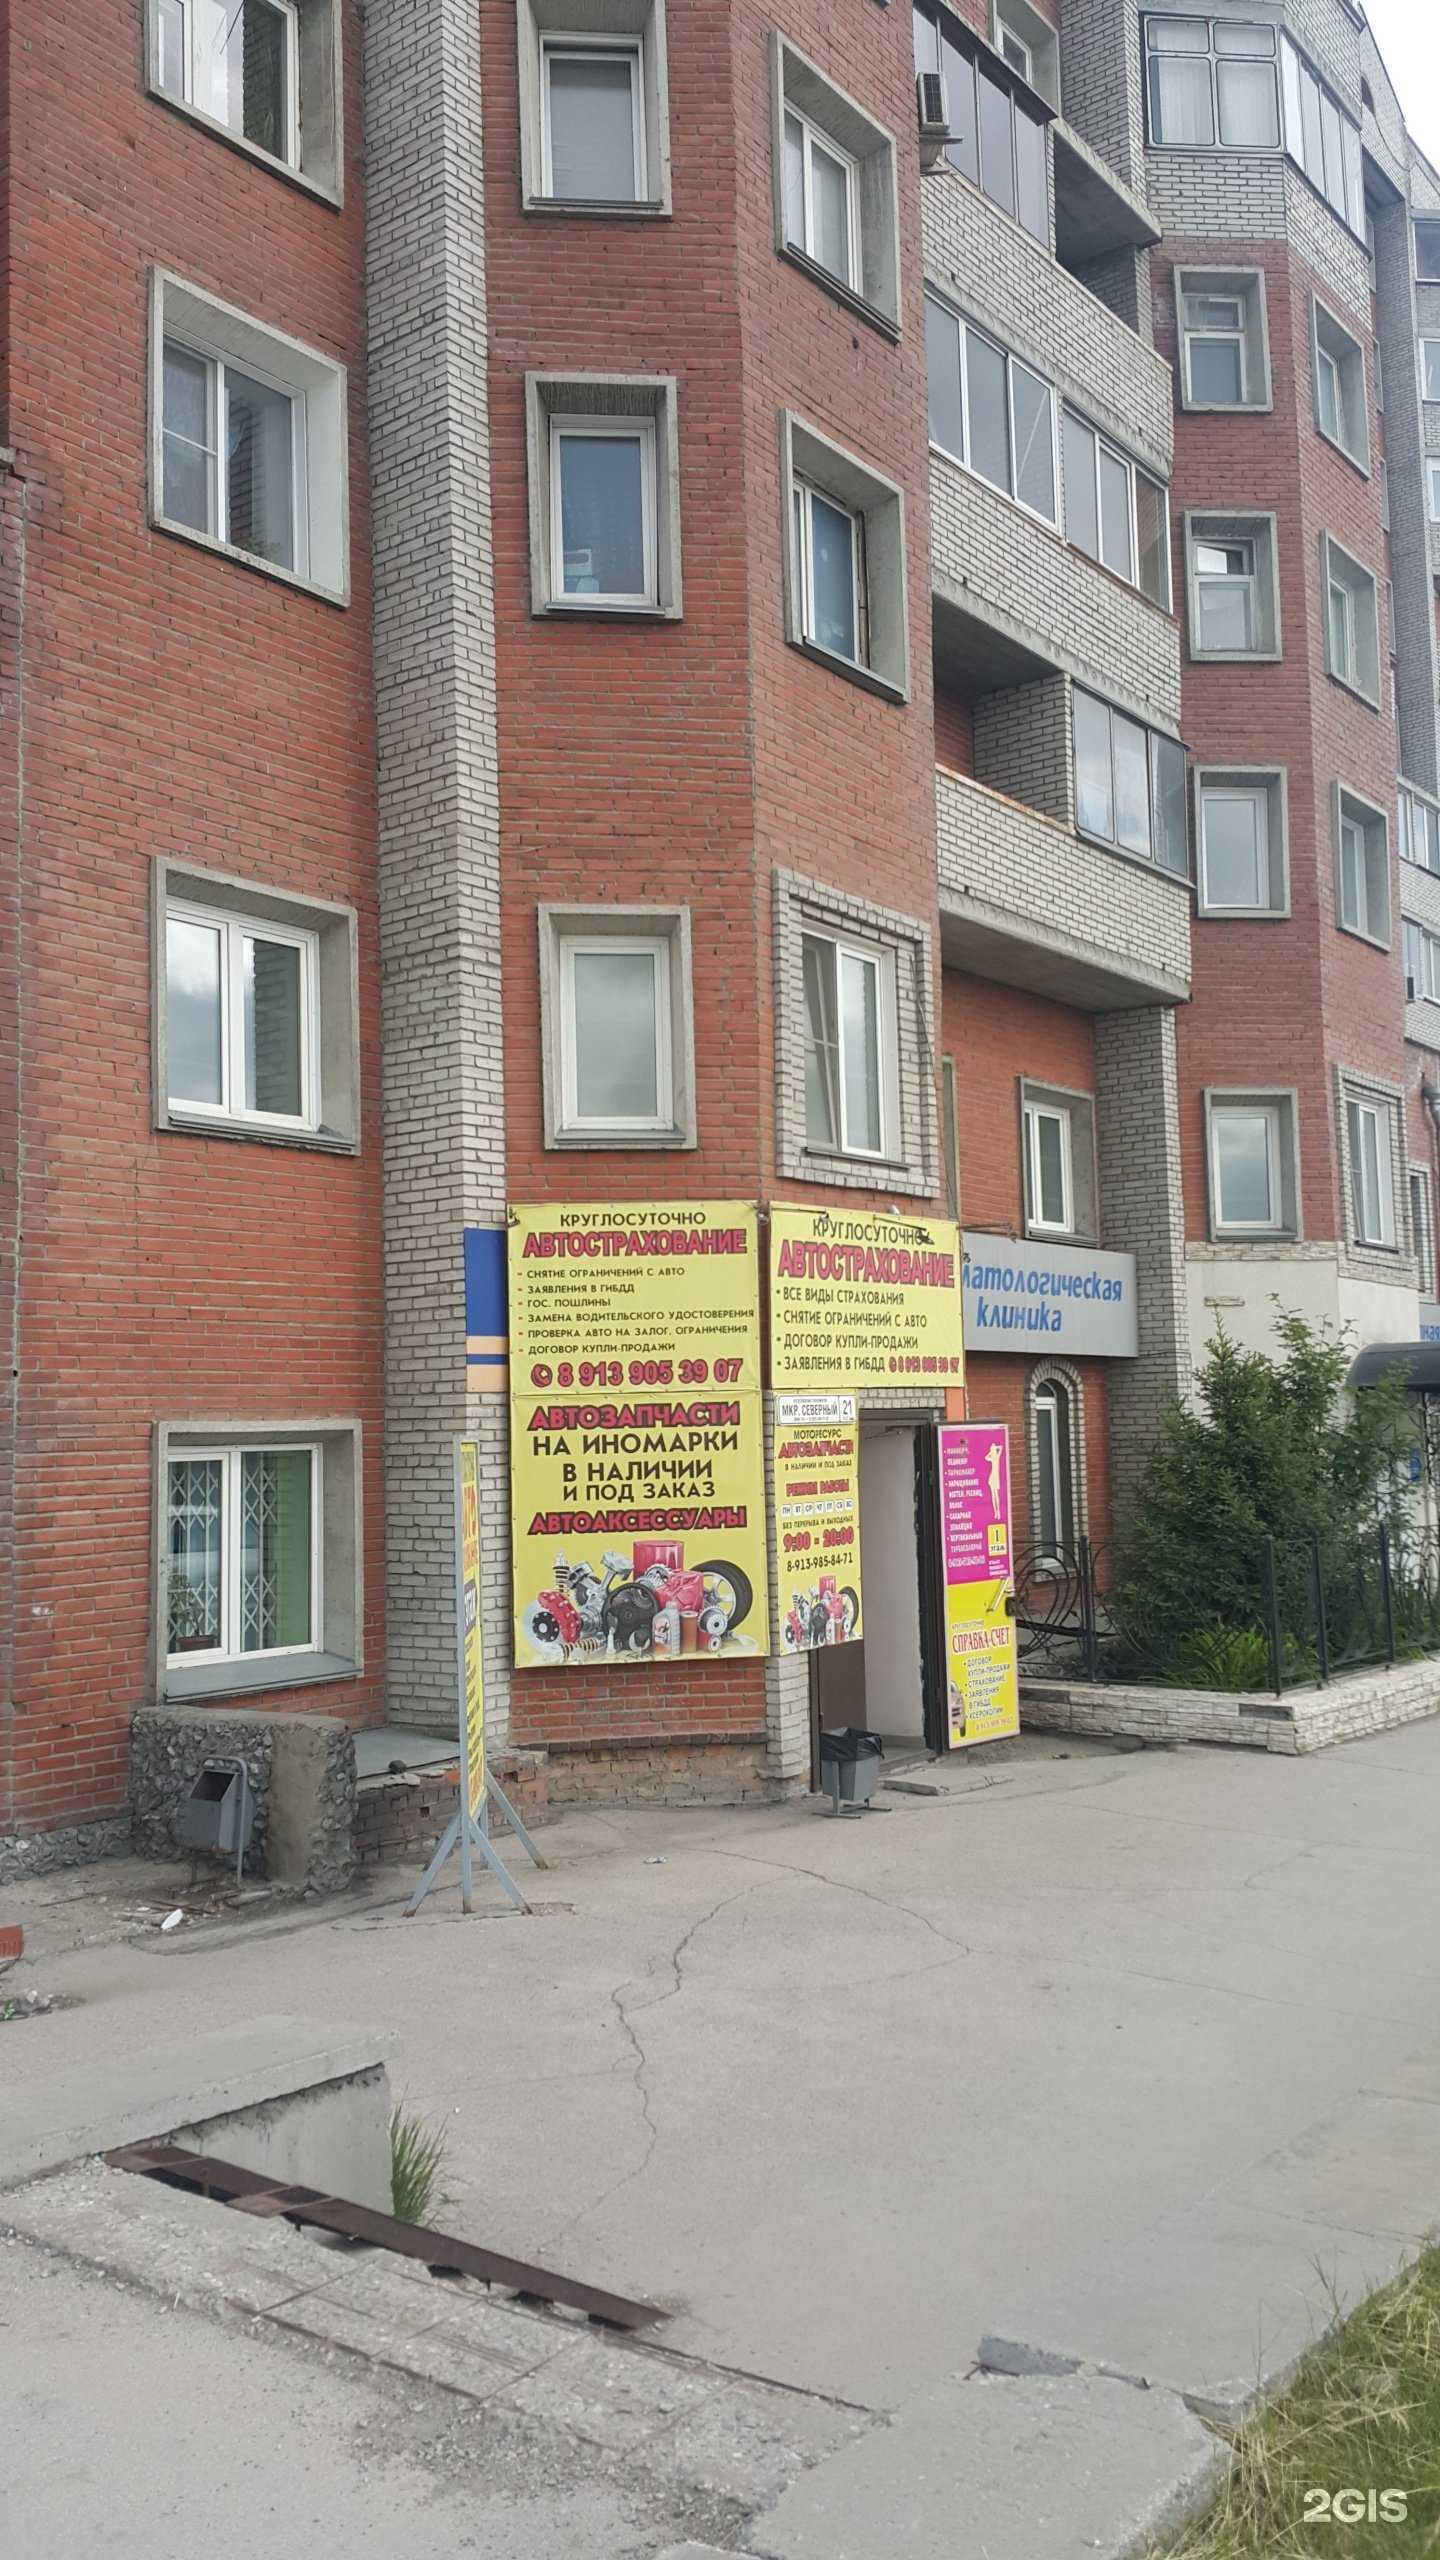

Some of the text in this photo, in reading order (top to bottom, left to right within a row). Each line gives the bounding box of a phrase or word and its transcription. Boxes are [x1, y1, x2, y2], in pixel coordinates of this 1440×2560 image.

[560, 1211, 707, 1227] КРУГЛОСУТОЧНО
[812, 1218, 924, 1246] КРУГЛОСУТОЧНО
[522, 1228, 748, 1258] АВТОСТРАХОВАНИЕ
[777, 1238, 955, 1288] АВТОСТРАХОВАНИЕ
[526, 1267, 685, 1279] СНЯТИЕ ОГРАНИЧЕНИЙ С АВТО
[527, 1283, 635, 1294] ЗАЯВЛЕНИЯ В ГИБДД
[783, 1286, 904, 1305] ВСЕ ВИДЫ СТРАХОВАНИЯ
[527, 1298, 611, 1308] ГОС. ПОШЛИНЫ
[528, 1309, 754, 1323] ЗАМЕНА ВОДИТЕЛЬСКОГО УДОСТОВЕРЕНИЯ
[783, 1310, 927, 1328] СНЯТИЕ ОГРАНИЧЕНИЙ С АВТО
[976, 1296, 1062, 1332] клиника
[528, 1328, 581, 1339] ПРОВЕРКА
[585, 1328, 612, 1337] АВТО
[616, 1328, 631, 1337] НА
[675, 1325, 748, 1335] ОГРАНИЧЕНИЯ
[528, 1343, 676, 1355] ДОГОВОР КУПЛИ-ПРОДАЖИ
[784, 1334, 918, 1351] ДОГОВОР КУПЛИ-ПРОДАЖИ
[557, 1358, 744, 1387] 8 913 905 39 07
[784, 1356, 885, 1373] ЗАЯВЛЕНИЯ В ГИБДД
[527, 1401, 741, 1431] АВТОЗАПЧАСТИ
[782, 1400, 852, 1416] МКР. СЕВЕРНЫЙ 21
[532, 1431, 738, 1456] НА ИНОМАРКИ
[793, 1428, 842, 1440] МОТОРЕСУРС
[562, 1459, 713, 1482] В НАЛИЧИИ
[563, 1482, 716, 1503] И ПОД ЗАКАЗ
[527, 1506, 748, 1536] АВТОАКСЕССУАРЫ
[783, 1531, 812, 1553] 9:00
[822, 1526, 855, 1548] 20:00
[787, 1552, 853, 1572] 8-913-985-84-71
[952, 1626, 1010, 1653] СПРАВКА-СЧЕТ
